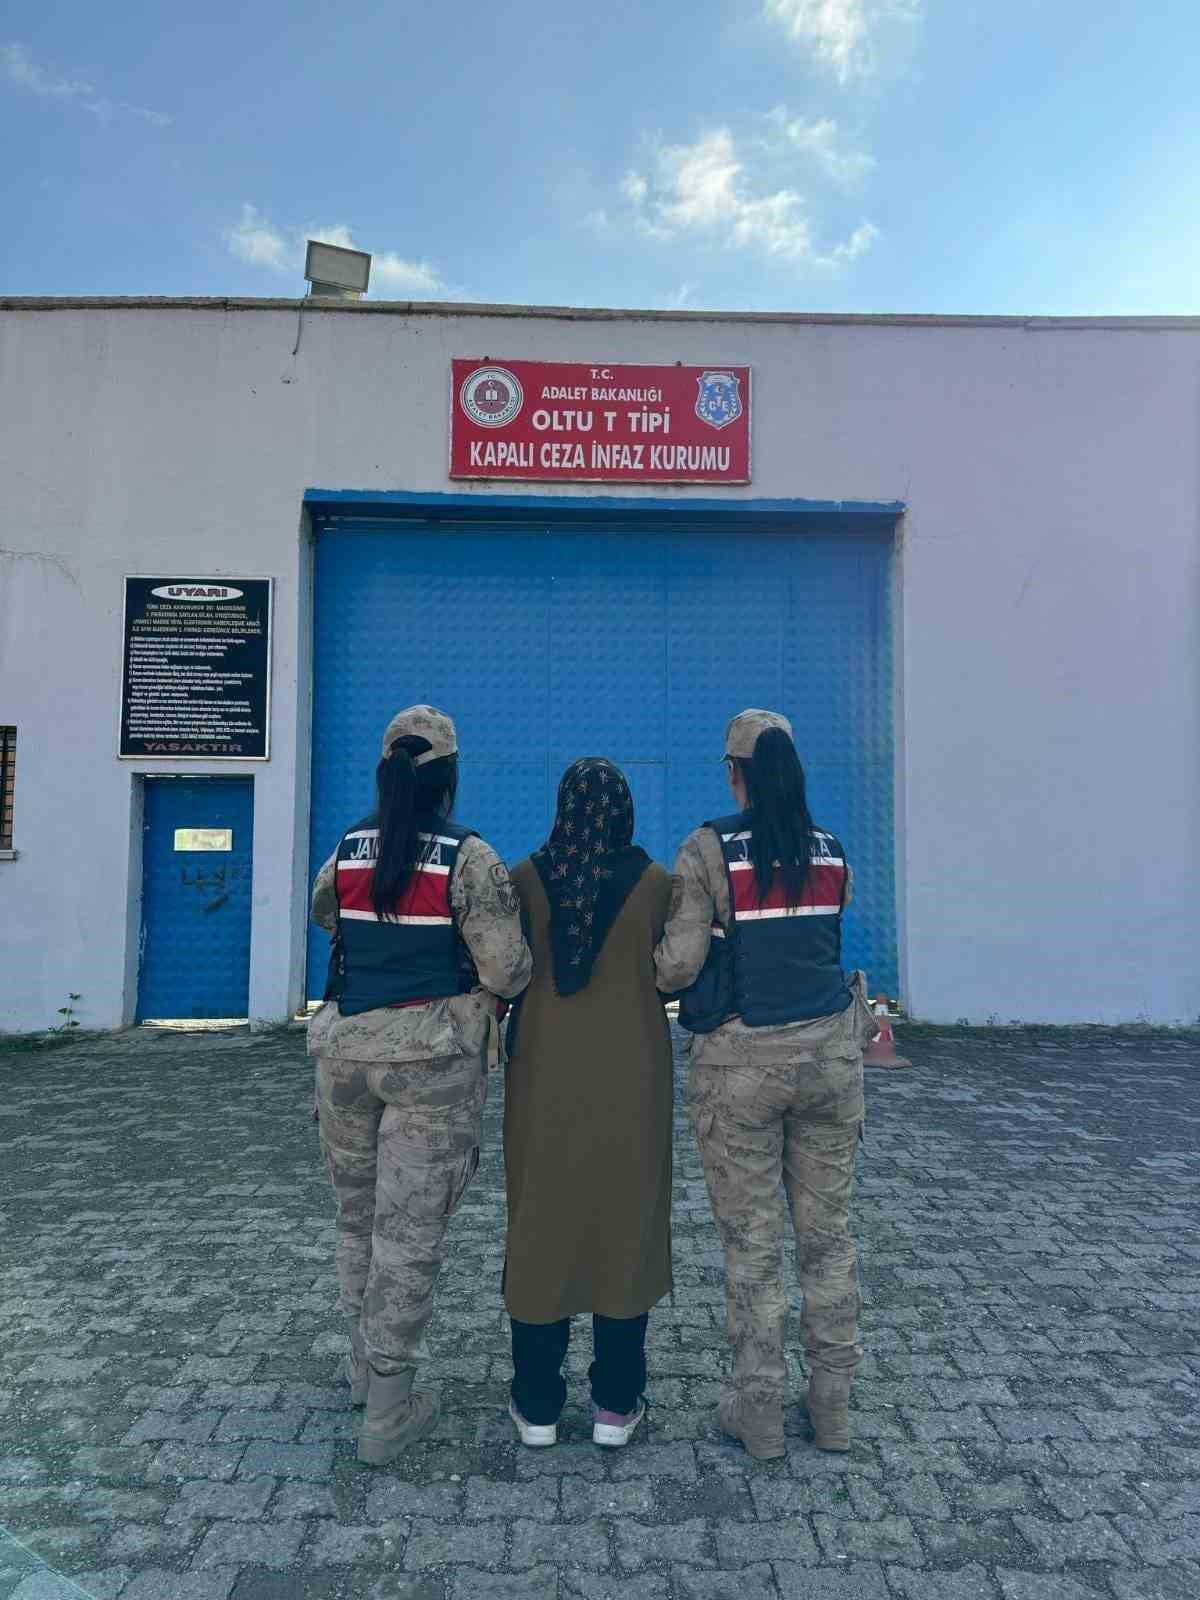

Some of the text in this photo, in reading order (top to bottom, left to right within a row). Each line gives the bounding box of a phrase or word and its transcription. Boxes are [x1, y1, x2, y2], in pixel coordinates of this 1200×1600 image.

[590, 368, 614, 380] T.C.
[541, 386, 662, 402] ADALET BAKANLIĞI
[532, 405, 671, 434] OLTU T TİPİ
[470, 440, 730, 472] KAPALI CEZA İNFAZ KURUMU
[167, 587, 228, 598] UYARI
[143, 742, 242, 752] YASAKTIR
